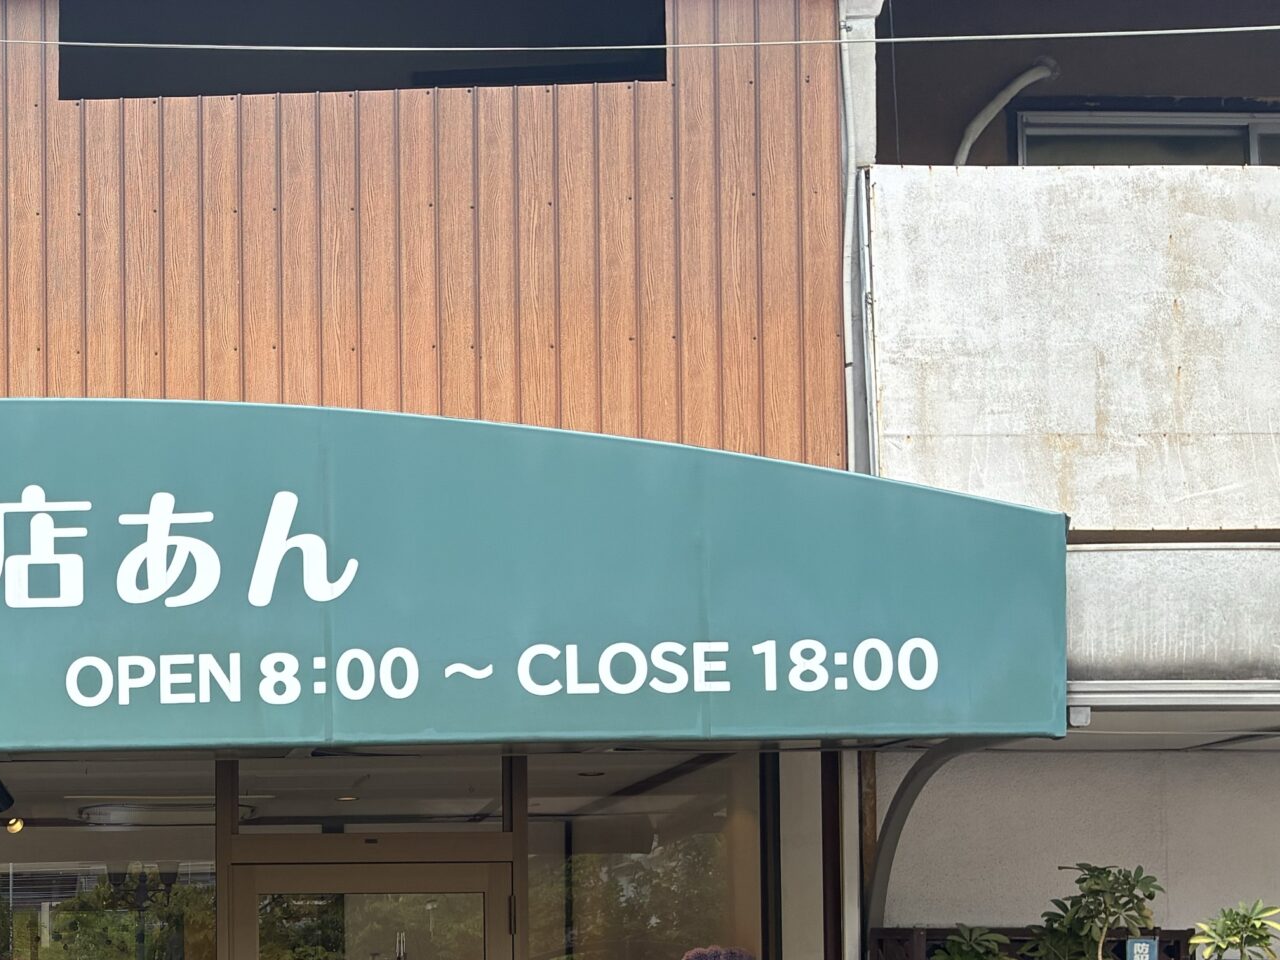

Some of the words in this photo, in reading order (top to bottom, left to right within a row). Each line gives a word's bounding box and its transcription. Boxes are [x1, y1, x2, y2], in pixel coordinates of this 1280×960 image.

[65, 652, 241, 707] OPEN
[258, 647, 419, 705] 8:00
[517, 641, 731, 696] CLOSE
[751, 637, 939, 692] 18:00
